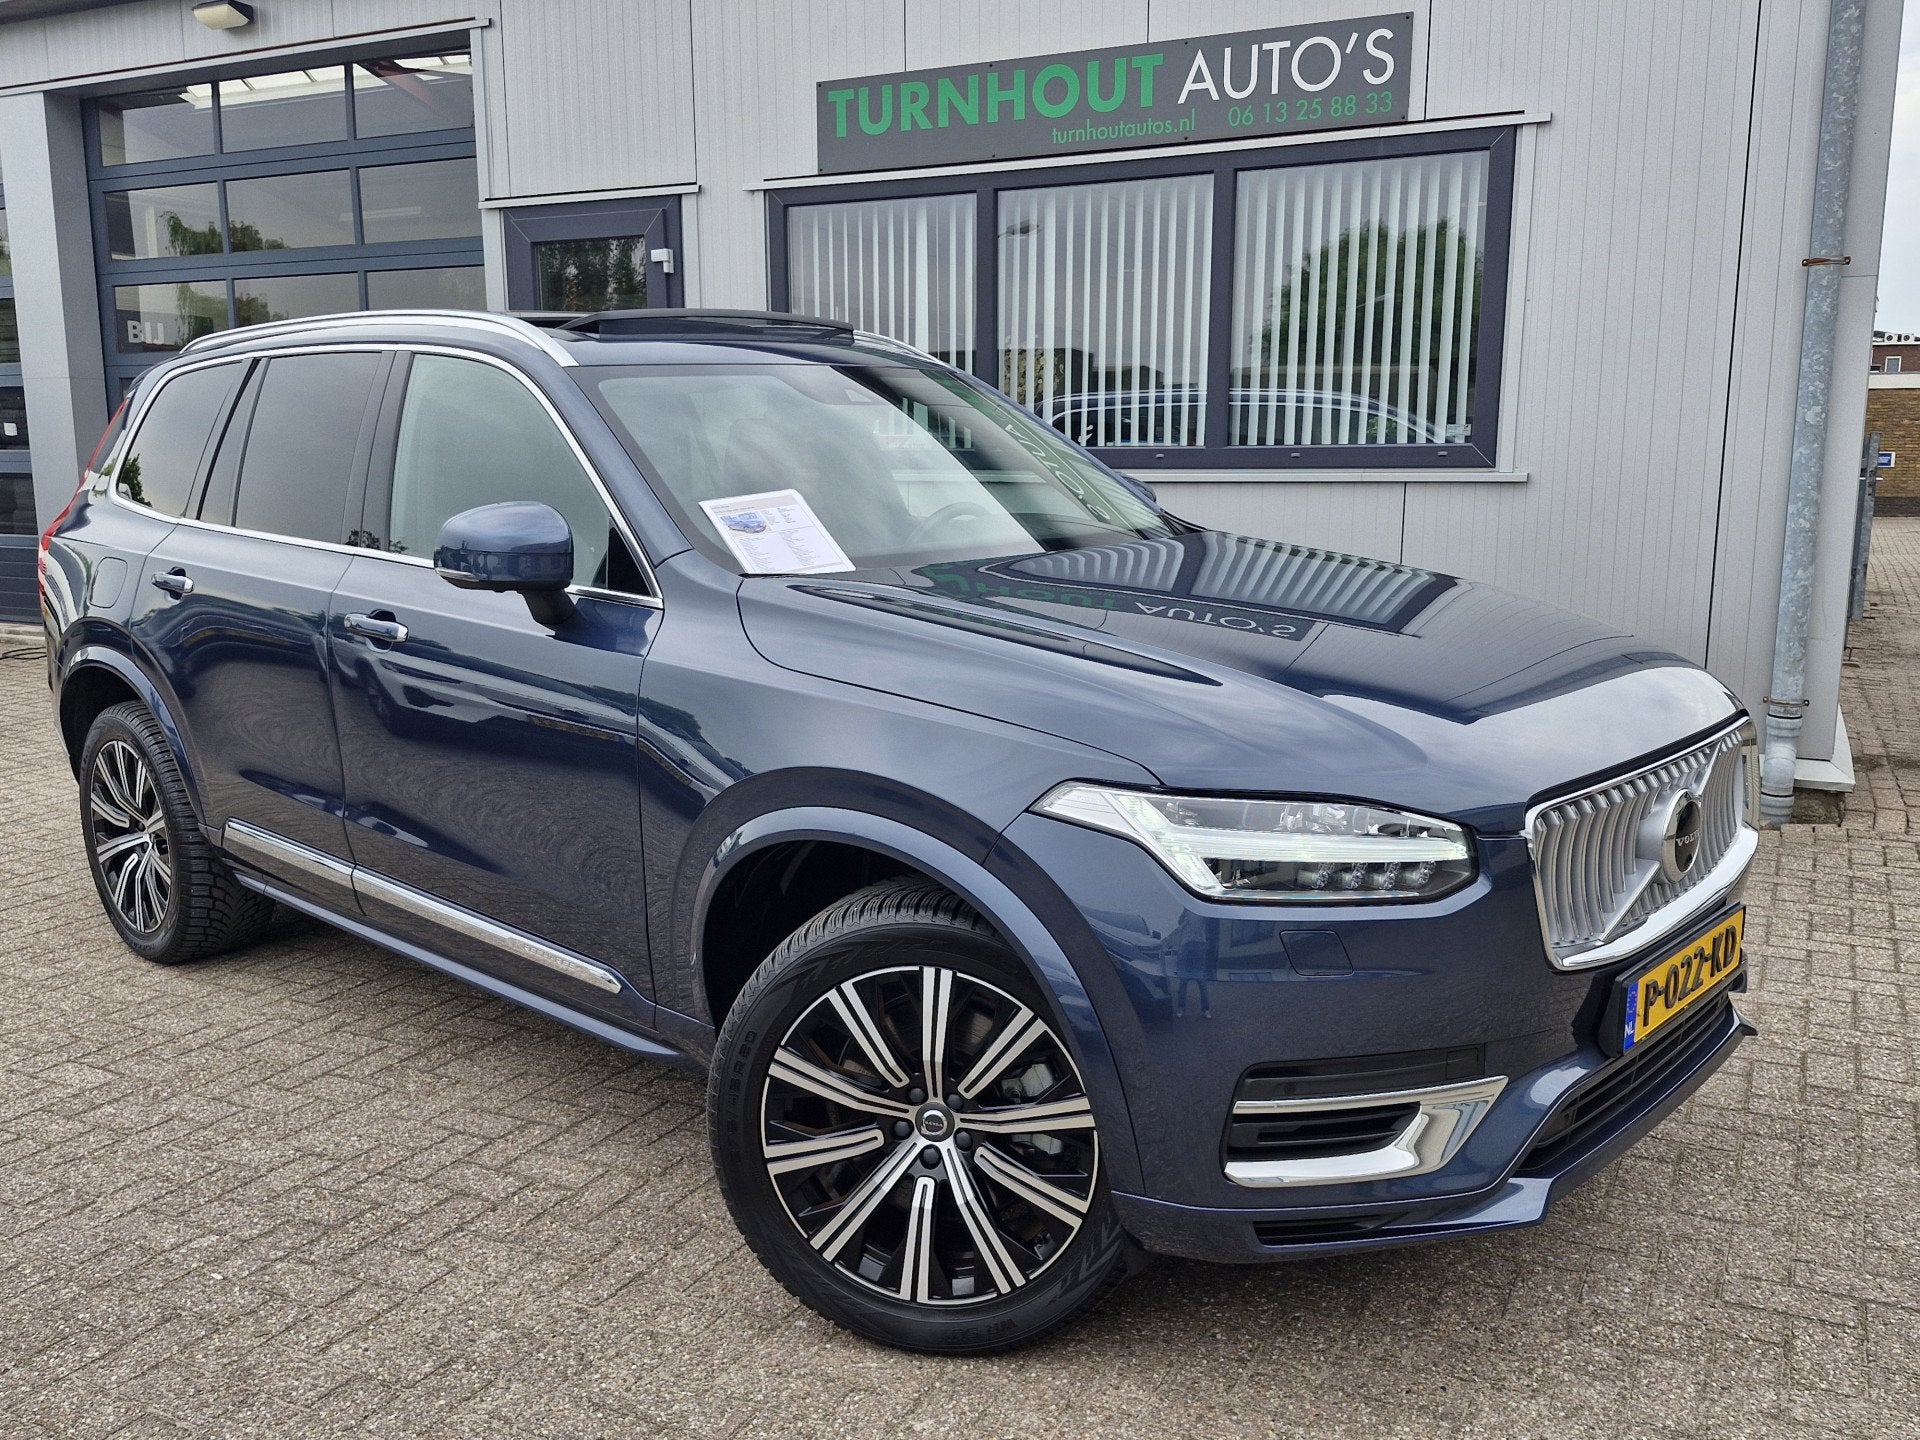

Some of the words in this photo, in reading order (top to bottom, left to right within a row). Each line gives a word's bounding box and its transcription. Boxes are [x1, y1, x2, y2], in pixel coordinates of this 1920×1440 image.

[828, 53, 1164, 138] TURNHOUT
[1177, 28, 1395, 105] AUTO'S
[1052, 108, 1196, 144] turnhoutautos.nl
[1228, 106, 1254, 127] 06
[1263, 102, 1288, 123] 13
[1295, 98, 1322, 121] 25
[1330, 94, 1357, 117] 88
[1365, 91, 1393, 113] 33
[1675, 828, 1702, 847] VOLV
[1643, 925, 1738, 1027] P-022-KD
[1624, 1022, 1635, 1038] NL
